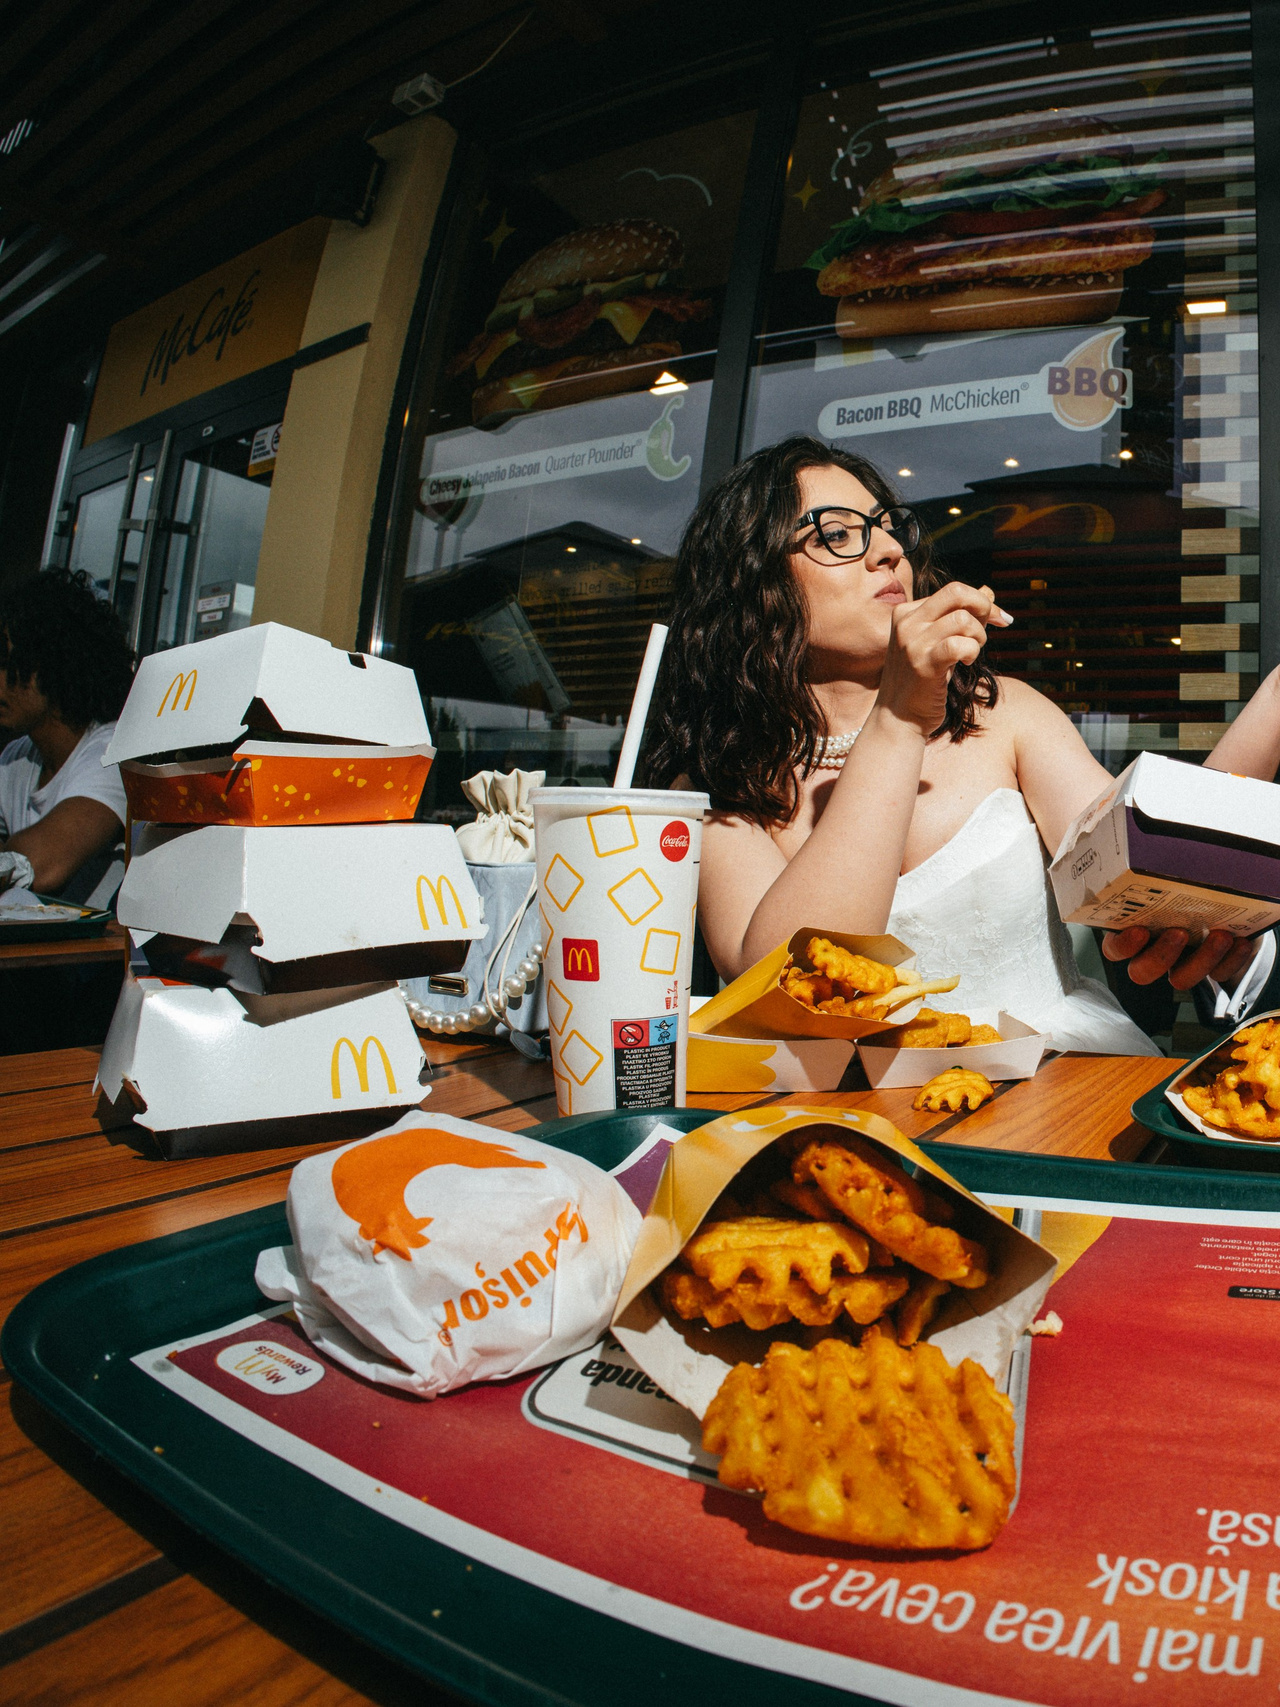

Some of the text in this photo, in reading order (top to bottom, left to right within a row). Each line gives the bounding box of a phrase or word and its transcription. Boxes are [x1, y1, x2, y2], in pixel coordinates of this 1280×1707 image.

[140, 269, 260, 396] McCafé
[1048, 367, 1129, 405] BBQ
[836, 407, 883, 426] Bacon
[887, 398, 921, 419] BBQ
[429, 479, 461, 496] Cheesy
[462, 465, 506, 489] Jalapeño
[508, 461, 540, 477] Bacon
[545, 453, 585, 474] Quarter
[1239, 1287, 1276, 1295] Store
[254, 1345, 312, 1376] Rewards
[788, 1562, 979, 1636] ceva?
[1086, 1553, 1250, 1621] kiosk
[983, 1598, 1122, 1668] vrea
[1130, 1625, 1265, 1684] mai
